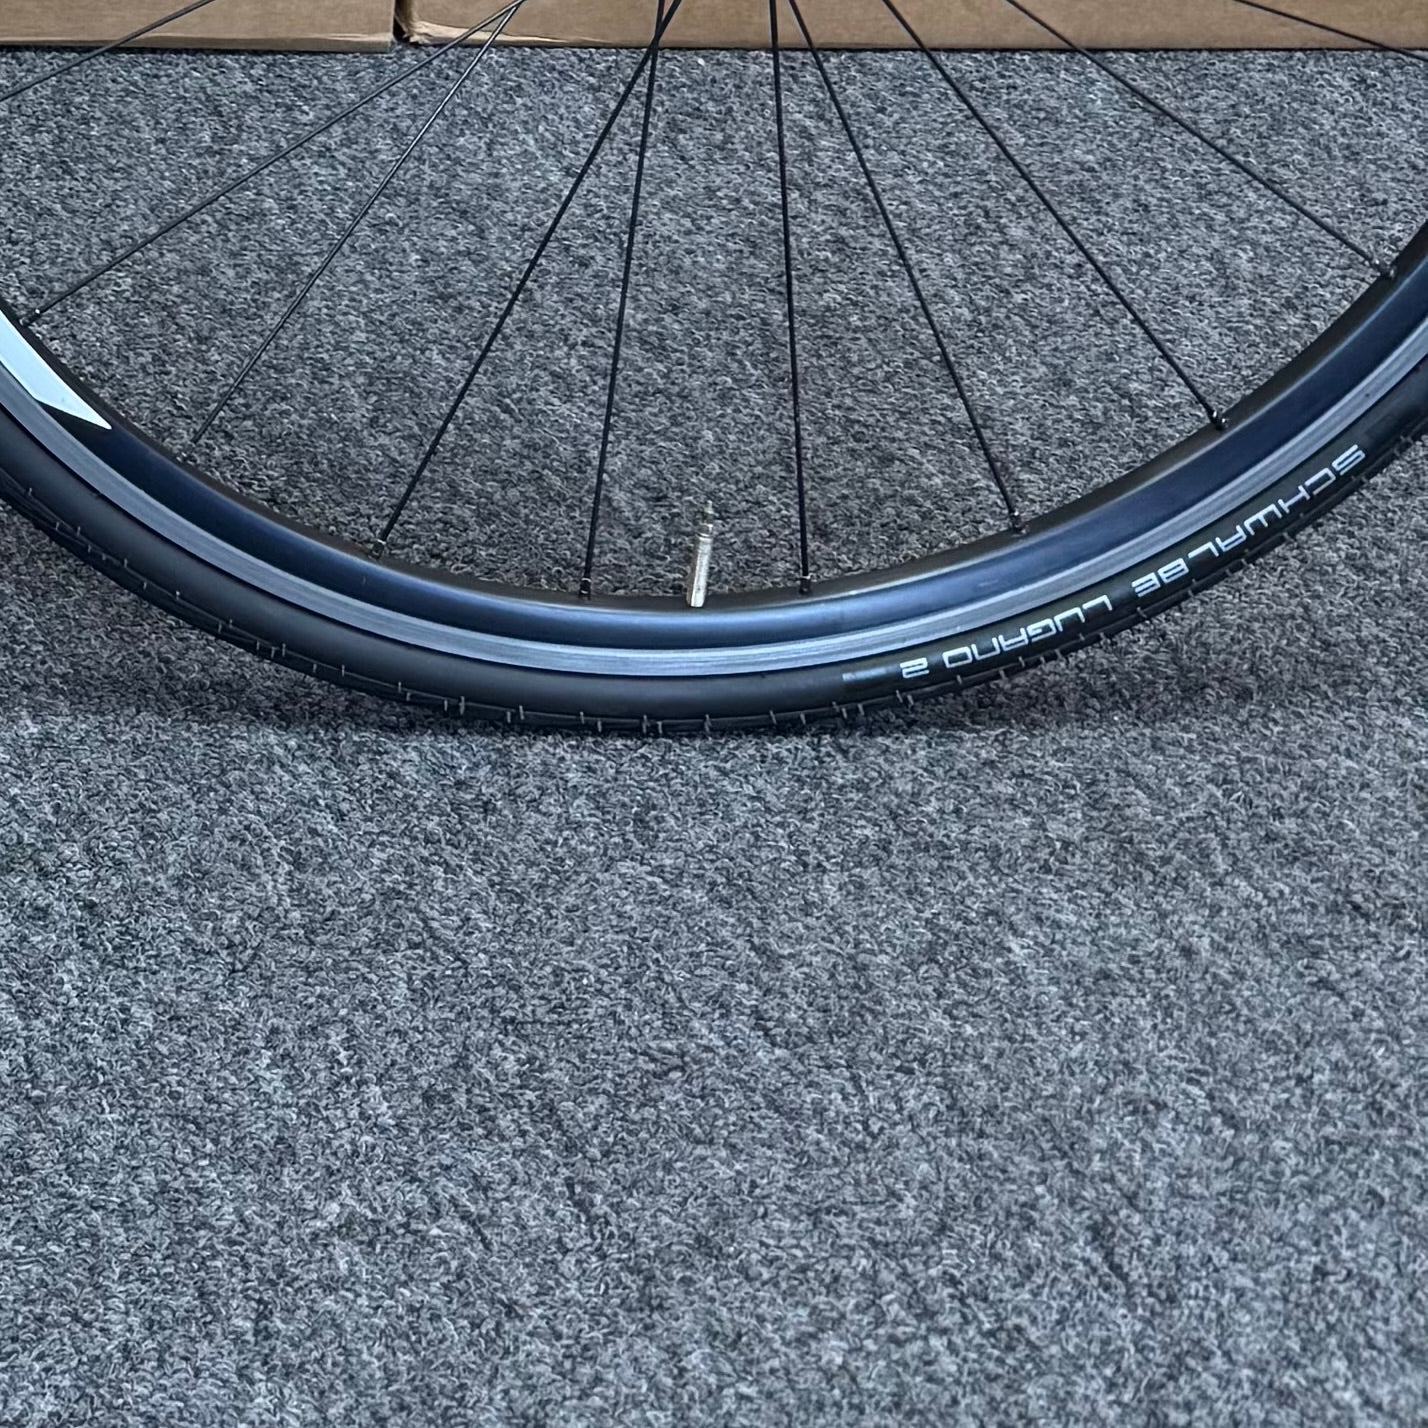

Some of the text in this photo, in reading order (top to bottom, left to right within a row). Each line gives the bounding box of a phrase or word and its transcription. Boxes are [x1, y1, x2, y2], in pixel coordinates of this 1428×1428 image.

[899, 444, 1366, 679] SCHWALBE LUGANO 2
